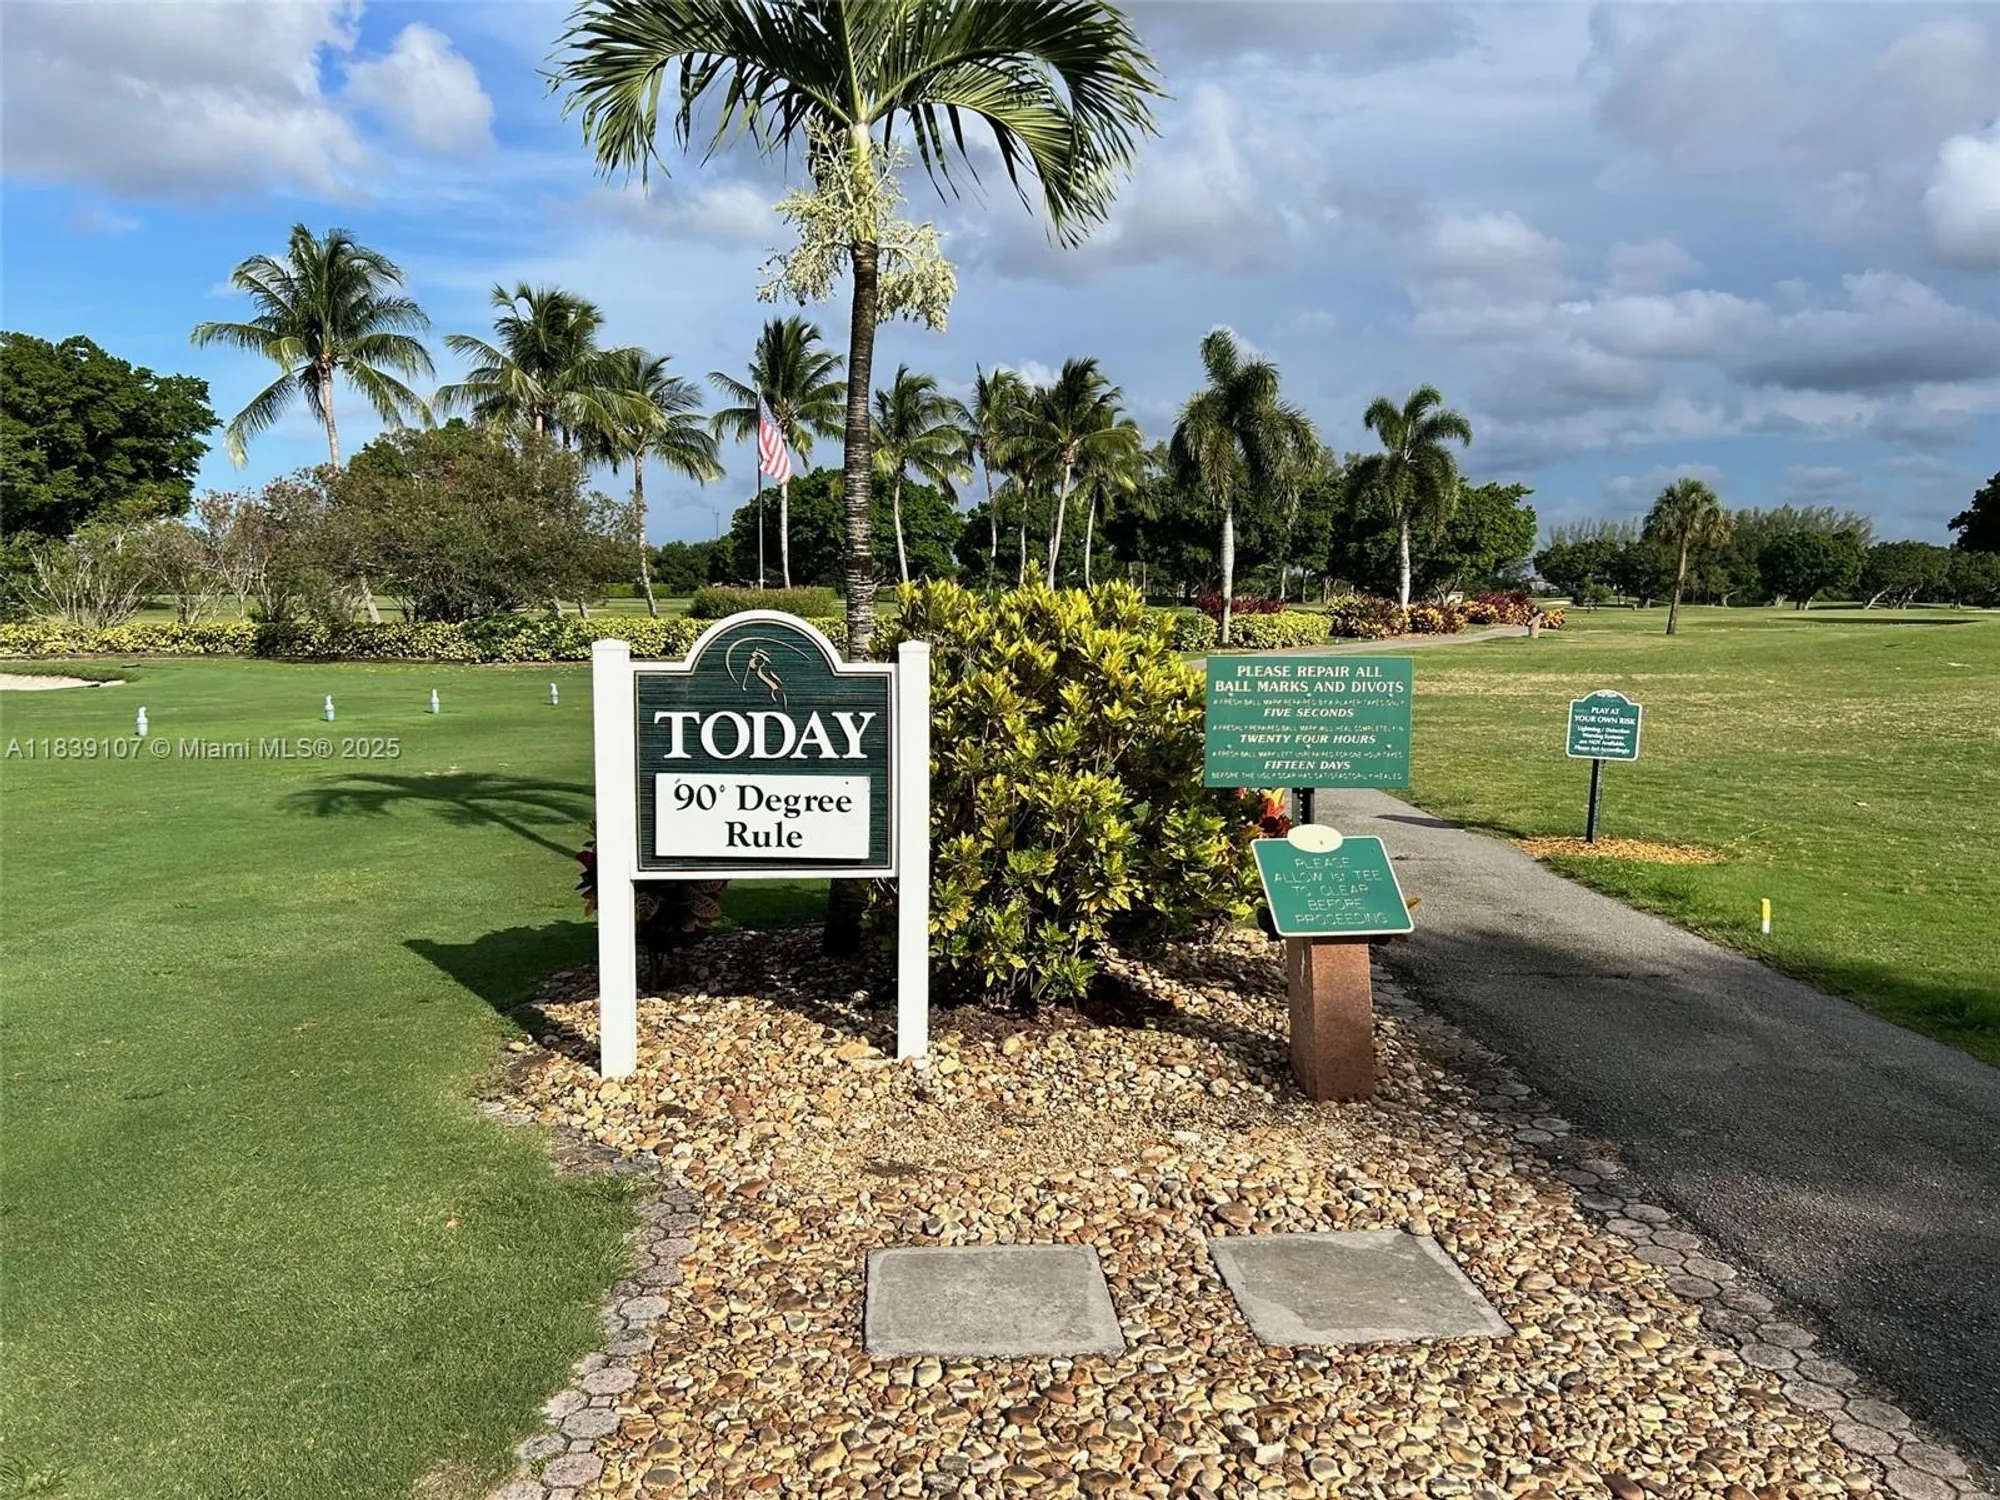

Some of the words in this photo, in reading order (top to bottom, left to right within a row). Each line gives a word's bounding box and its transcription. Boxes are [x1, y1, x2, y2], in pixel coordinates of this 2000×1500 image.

[1237, 665, 1291, 677] PLEASE
[1297, 666, 1350, 677] REPAIR
[1355, 666, 1382, 678] ALL
[1215, 680, 1251, 692] BALL
[1257, 680, 1309, 693] MARKS
[1313, 681, 1345, 693] AND
[1351, 681, 1404, 693] DIVOTS
[1263, 708, 1292, 718] FIVE
[1296, 708, 1354, 718] SECONDS
[1574, 714, 1596, 722] YOUR
[1618, 717, 1636, 725] RISK
[654, 711, 876, 759] TODAY
[1240, 734, 1291, 744] TWENTY
[1294, 735, 1329, 744] FOUR
[1333, 735, 1376, 744] HOURS
[1264, 760, 1316, 770] FIFTEEN
[1320, 761, 1351, 770] DAYS
[736, 784, 852, 818] Degree
[724, 820, 803, 848] Rule
[1295, 857, 1351, 869] PLEASE
[1274, 872, 1322, 883] ALLOW
[1352, 870, 1383, 881] TEE
[1291, 886, 1312, 896] TO
[1320, 884, 1369, 896] CLEAR
[1307, 898, 1364, 911] BEFORE
[1295, 912, 1388, 925] PROCEEDING
